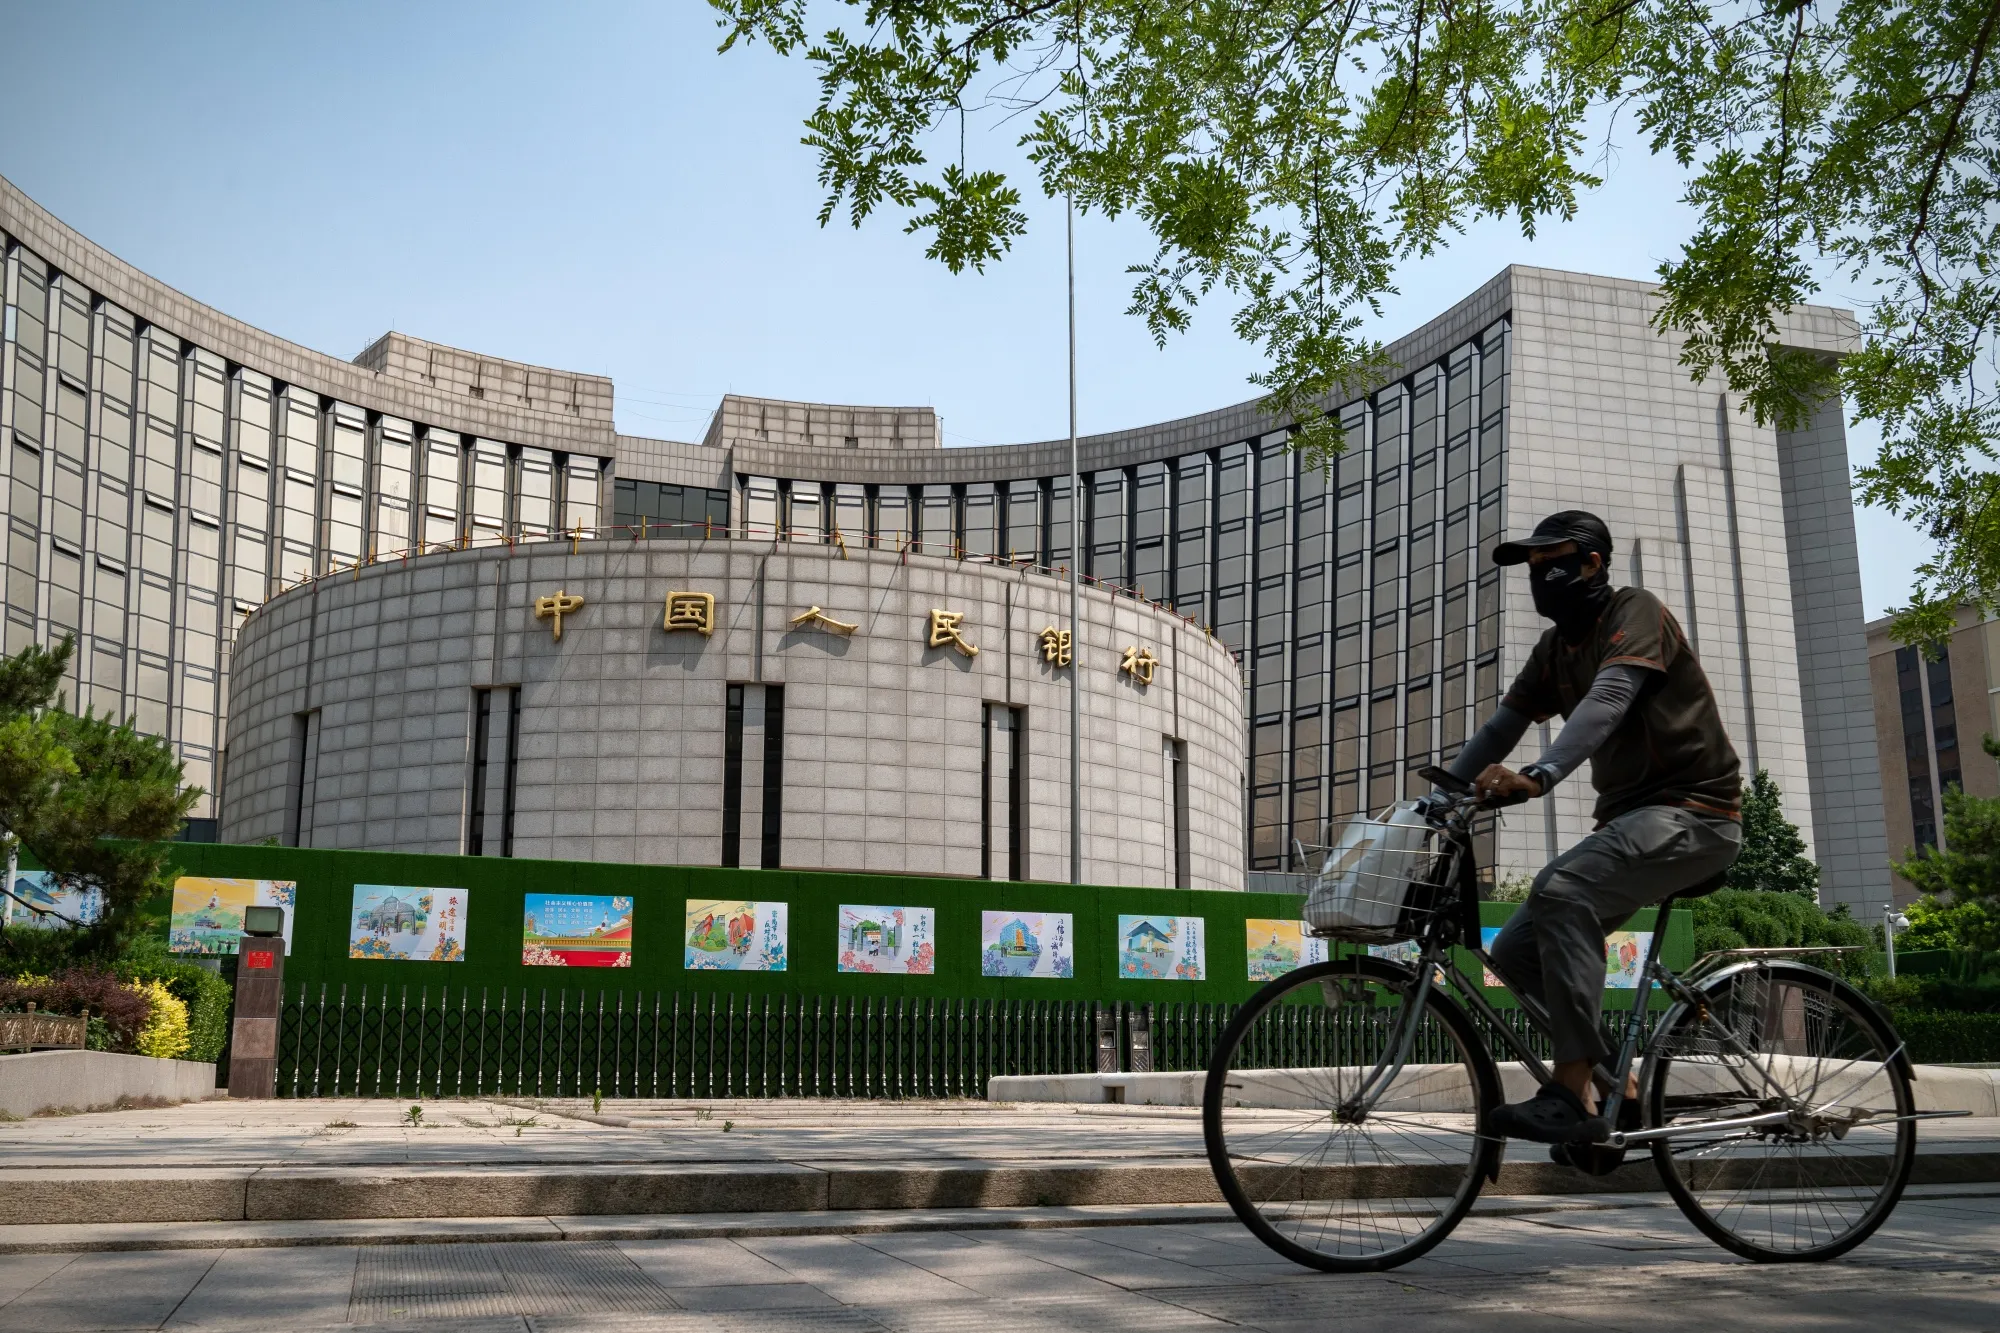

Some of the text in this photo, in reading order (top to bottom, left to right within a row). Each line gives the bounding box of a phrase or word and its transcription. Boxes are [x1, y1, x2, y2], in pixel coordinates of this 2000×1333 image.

[535, 589, 1160, 686] 中国人民银行
